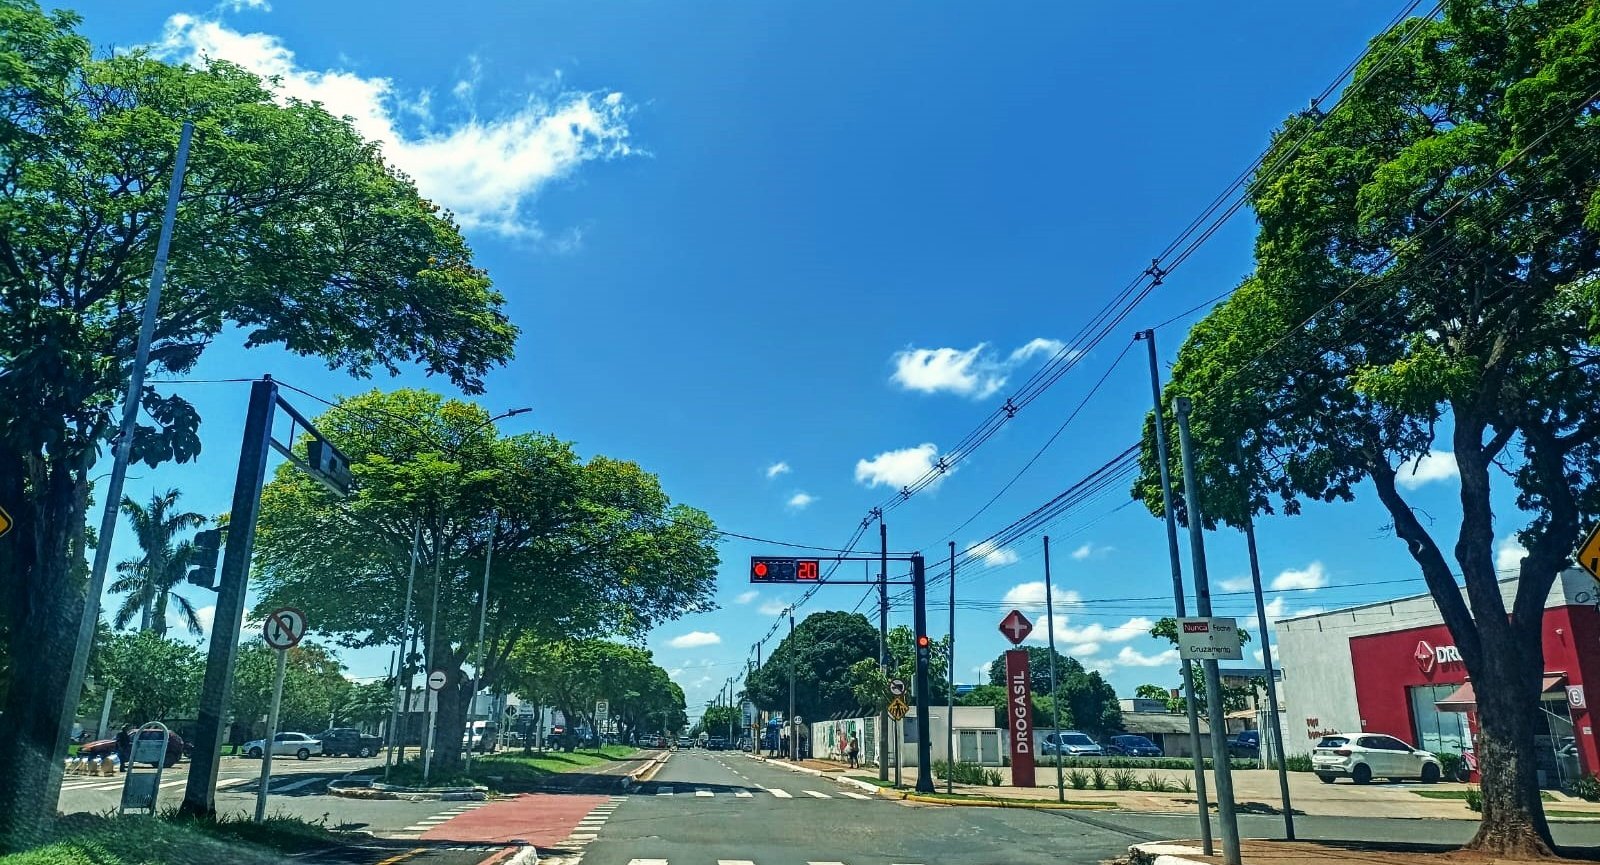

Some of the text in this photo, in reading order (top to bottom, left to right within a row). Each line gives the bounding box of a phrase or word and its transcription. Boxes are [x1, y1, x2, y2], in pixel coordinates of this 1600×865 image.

[798, 563, 816, 578] 20
[1184, 624, 1208, 632] Nunca
[1190, 645, 1231, 654] Cruzamento
[1013, 670, 1029, 754] DROGASIL
